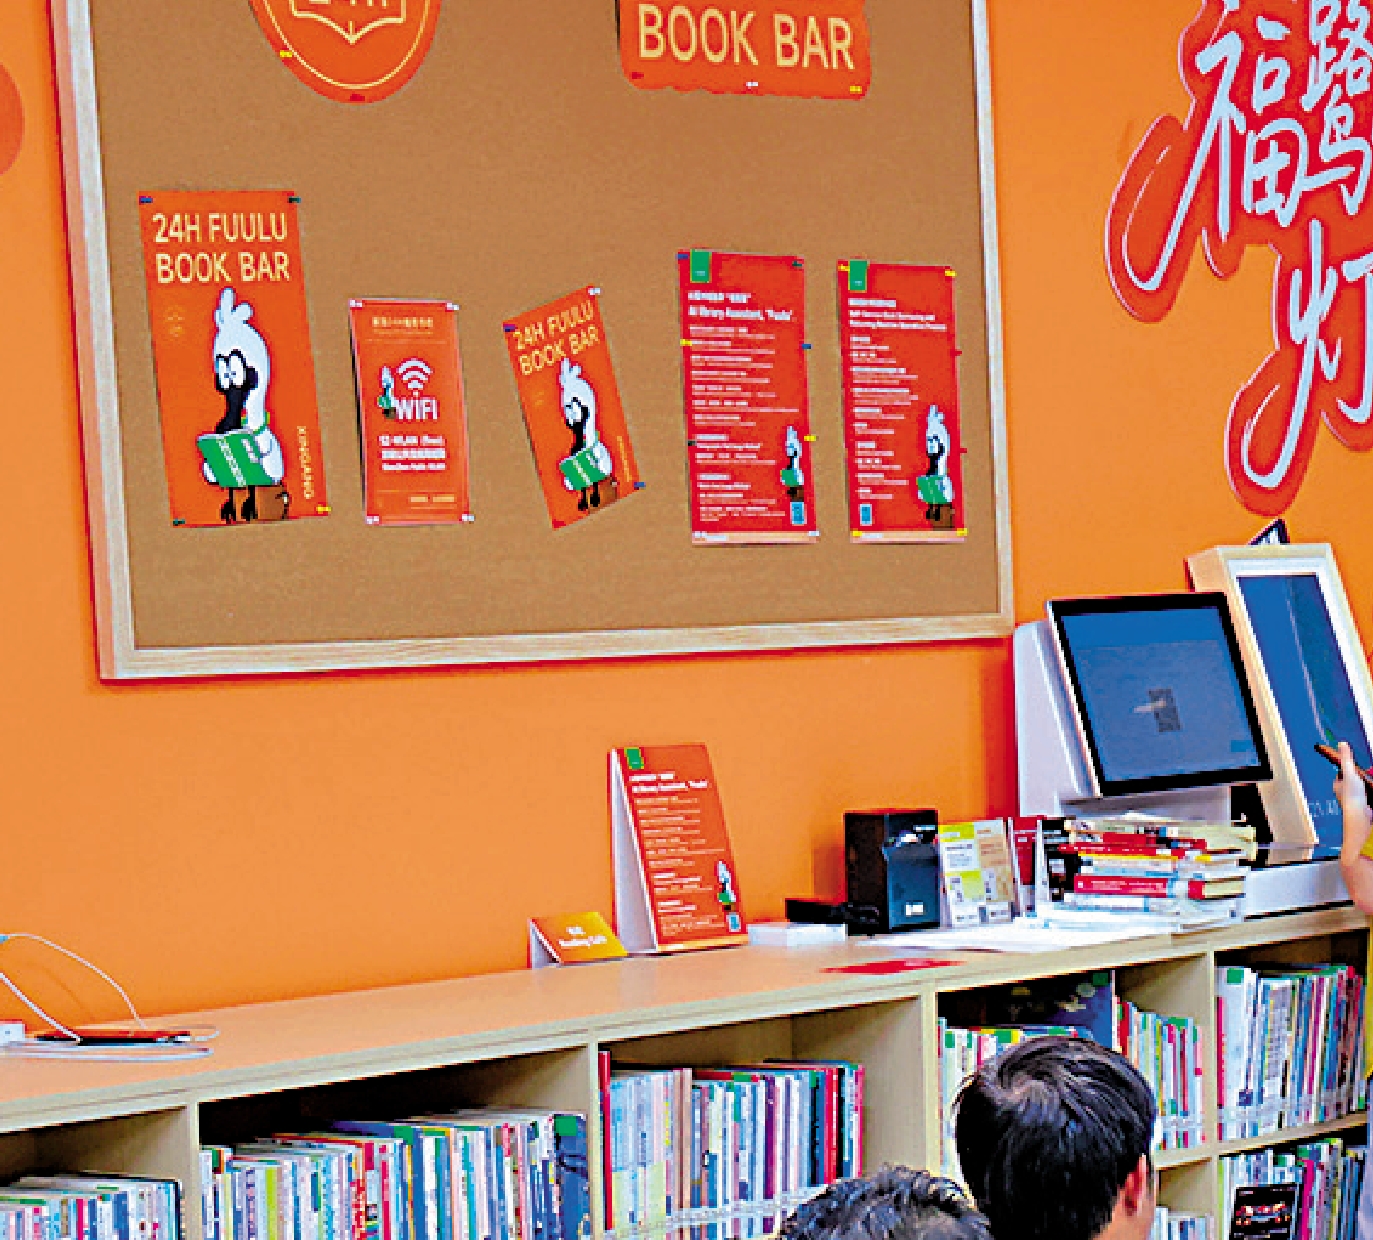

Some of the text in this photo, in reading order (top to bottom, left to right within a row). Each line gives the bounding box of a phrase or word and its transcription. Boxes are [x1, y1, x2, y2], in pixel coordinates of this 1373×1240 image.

[638, 4, 855, 70] BOOK BAR
[152, 212, 288, 243] 24H FUULU
[156, 251, 290, 284] BOOK BAR
[512, 321, 545, 351] 24H
[519, 324, 600, 376] BOOK BAR
